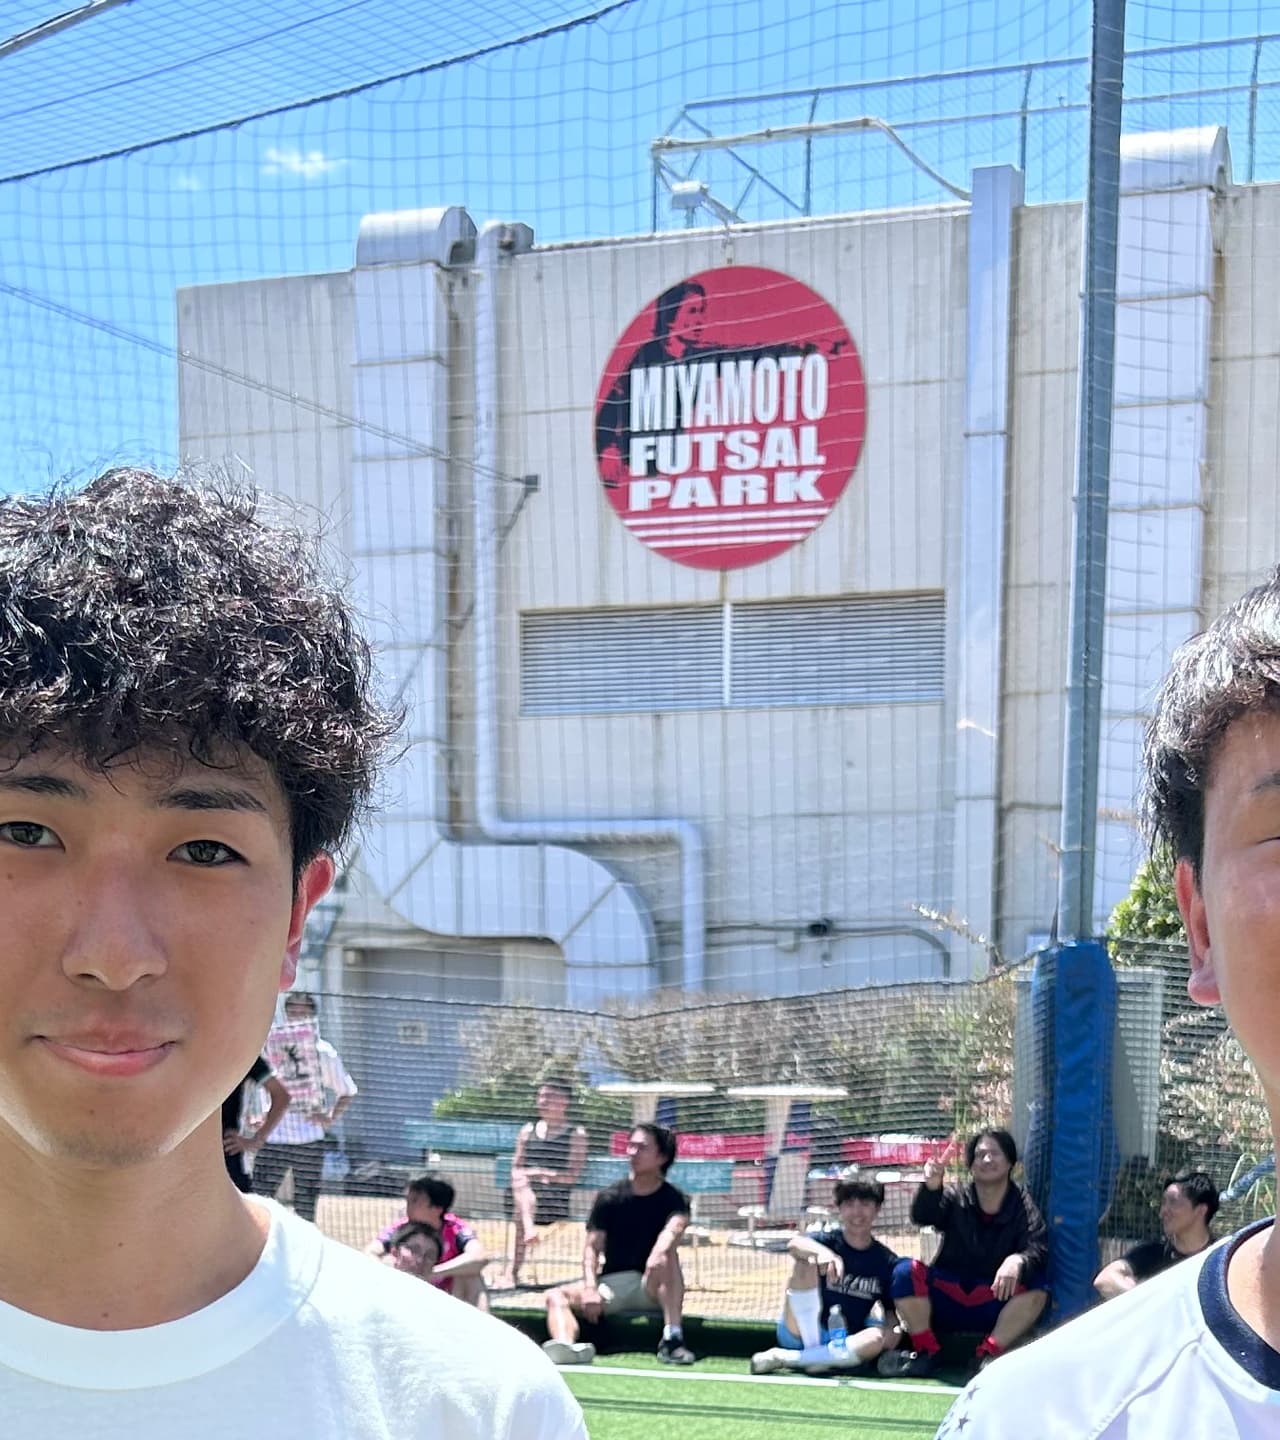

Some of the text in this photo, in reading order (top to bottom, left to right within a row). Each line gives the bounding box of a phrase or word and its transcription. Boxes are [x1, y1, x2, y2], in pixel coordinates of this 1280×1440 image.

[629, 354, 828, 432] MIYAMOTO
[629, 425, 826, 477] FUTSAL
[628, 470, 825, 512] PARK
